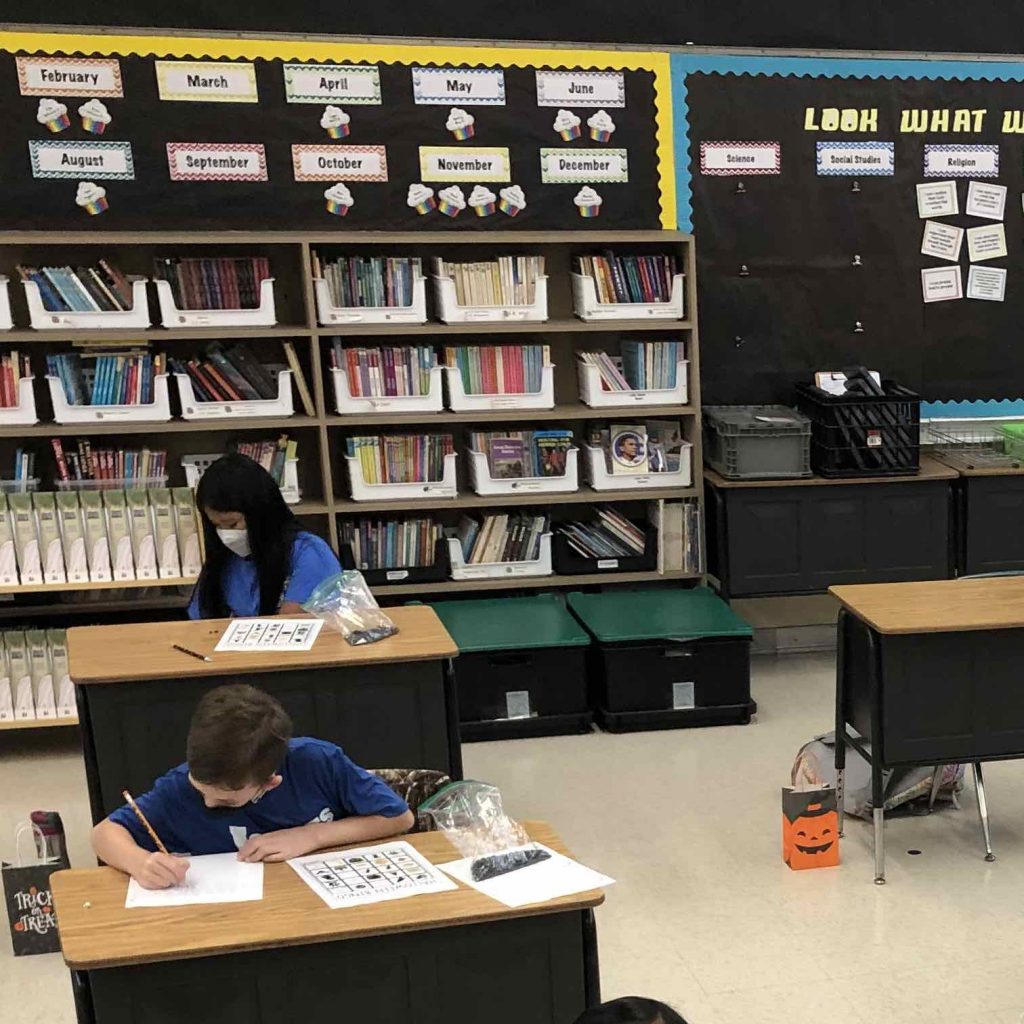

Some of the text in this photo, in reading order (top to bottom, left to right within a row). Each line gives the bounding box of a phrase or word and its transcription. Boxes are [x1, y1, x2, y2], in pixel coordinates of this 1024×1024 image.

[40, 69, 99, 85] February
[186, 75, 229, 88] March
[319, 77, 348, 90] April
[446, 79, 473, 94] May
[568, 82, 594, 95] June
[804, 108, 878, 132] LOOK
[900, 109, 987, 133] WHAT
[61, 153, 104, 167] August
[186, 155, 249, 169] September
[317, 157, 363, 169] October
[437, 158, 493, 171] November
[558, 159, 610, 171] December
[726, 153, 755, 164] Science
[830, 155, 881, 165] Social Studies
[947, 158, 976, 168] Religion
